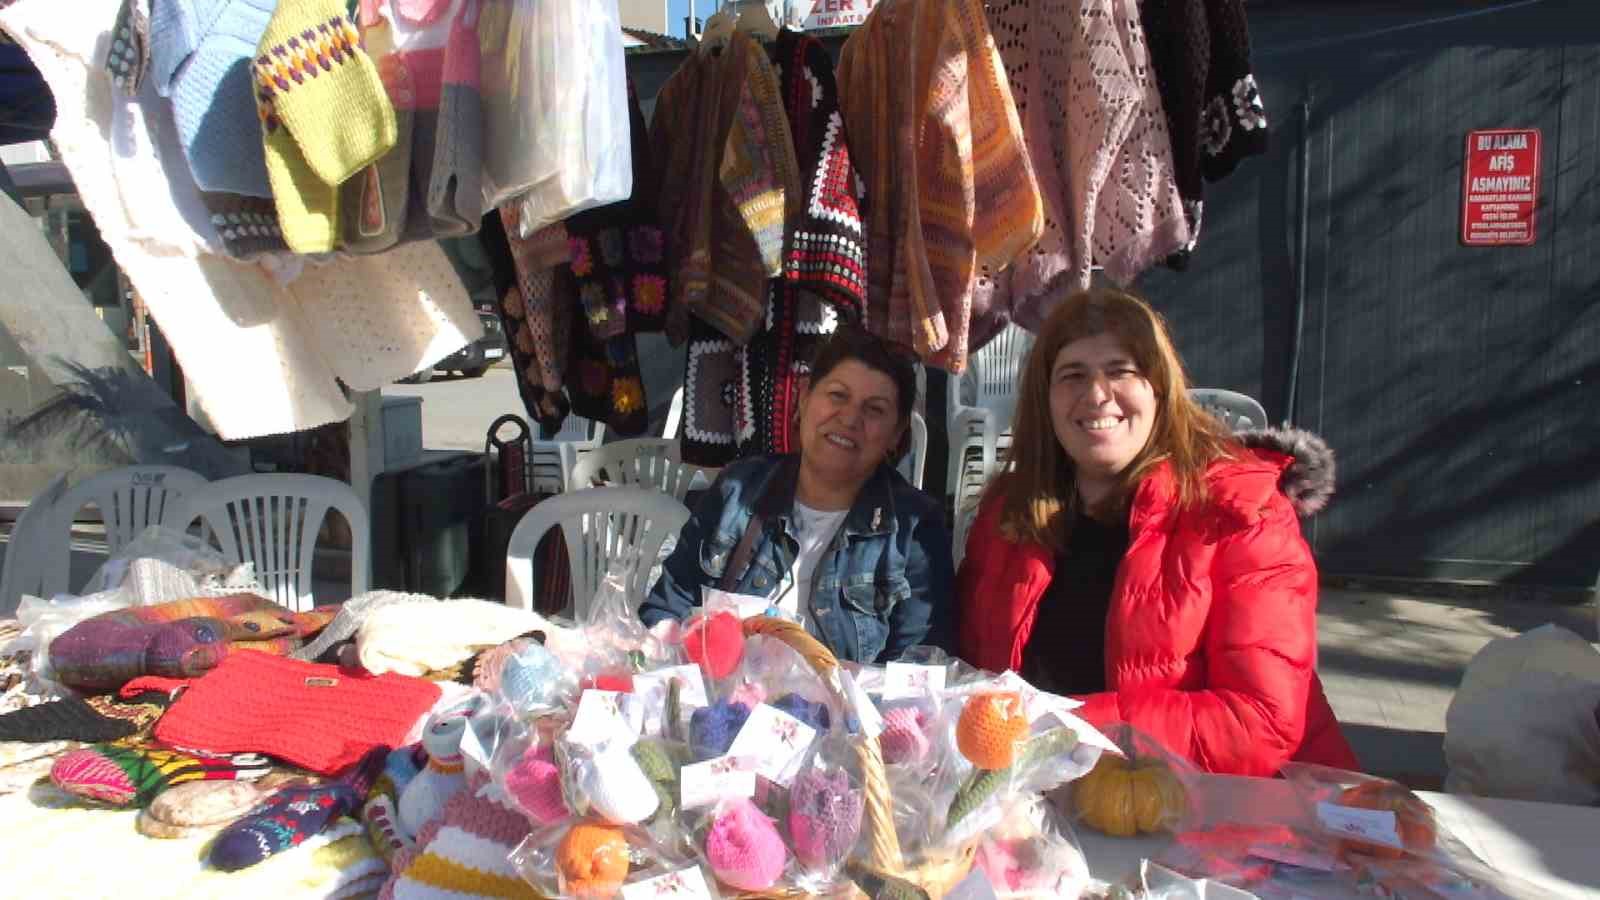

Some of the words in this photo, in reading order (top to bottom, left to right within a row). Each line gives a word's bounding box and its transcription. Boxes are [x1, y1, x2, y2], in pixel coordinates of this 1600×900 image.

[1477, 135, 1492, 151] BU
[1493, 134, 1528, 150] ALANA
[1489, 152, 1515, 174] AFİŞ
[1471, 176, 1531, 192] ASMAYINIZ
